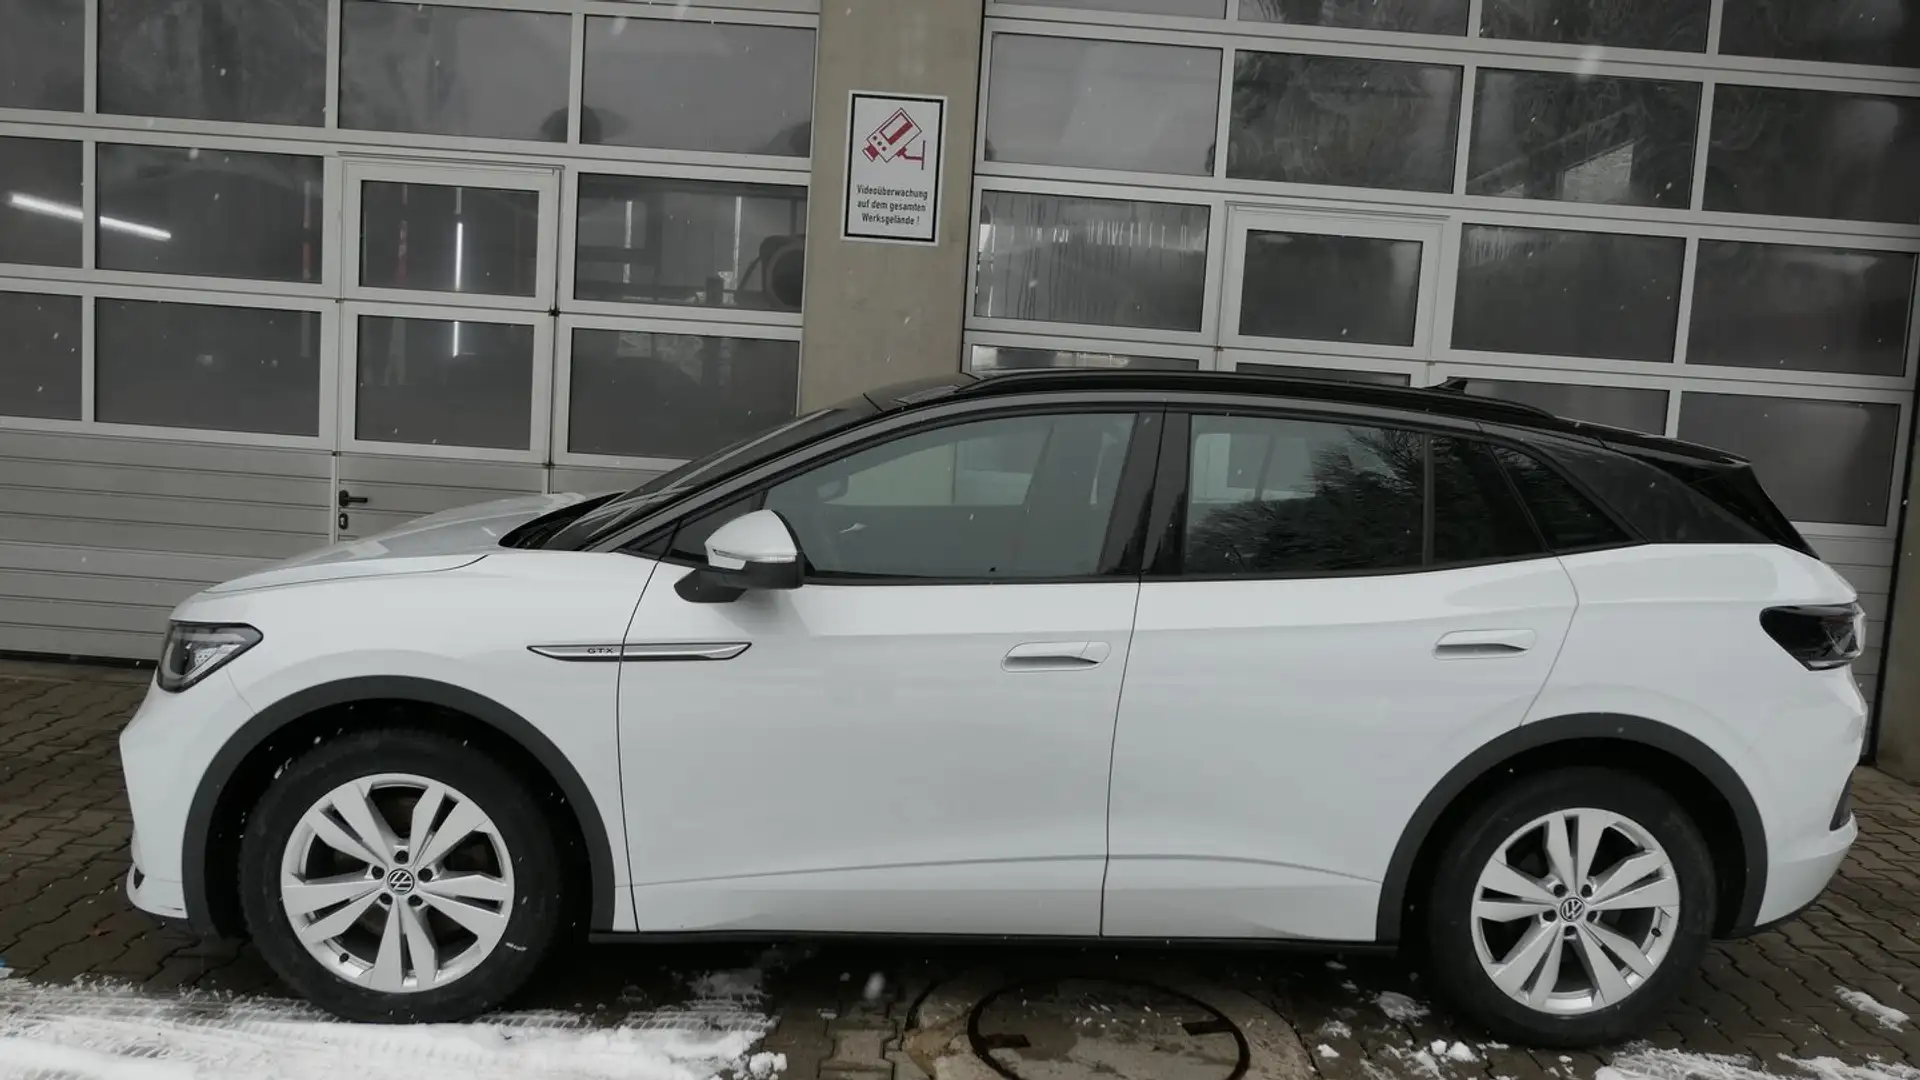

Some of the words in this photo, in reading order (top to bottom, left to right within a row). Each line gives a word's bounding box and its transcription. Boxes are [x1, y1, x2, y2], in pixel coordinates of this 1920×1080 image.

[857, 184, 928, 201] Videoüberwachung
[857, 199, 869, 208] auf
[871, 200, 888, 209] dem
[889, 202, 927, 212] gesamten
[862, 212, 915, 226] Werksgelände
